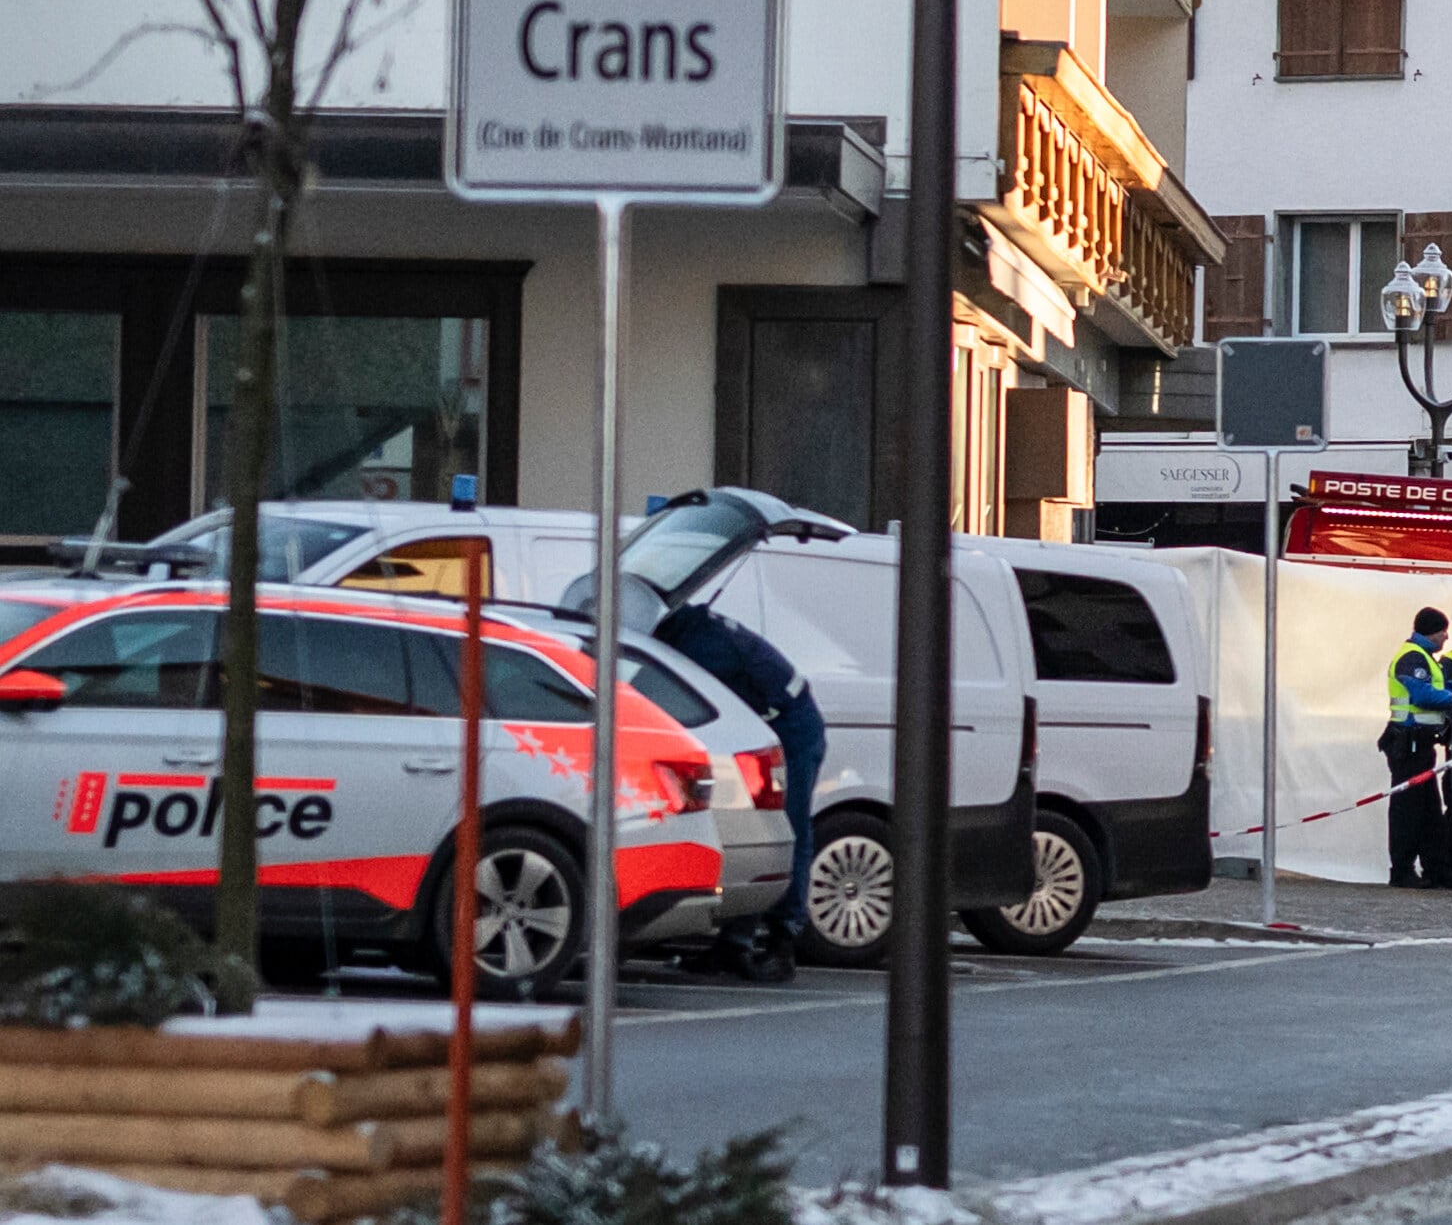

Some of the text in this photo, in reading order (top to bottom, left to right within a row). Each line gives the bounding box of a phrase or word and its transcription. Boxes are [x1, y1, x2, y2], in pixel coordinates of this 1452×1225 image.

[519, 0, 716, 82] Crans
[1325, 480, 1401, 499] POSTE
[1406, 486, 1438, 500] DE
[104, 776, 333, 848] polce
